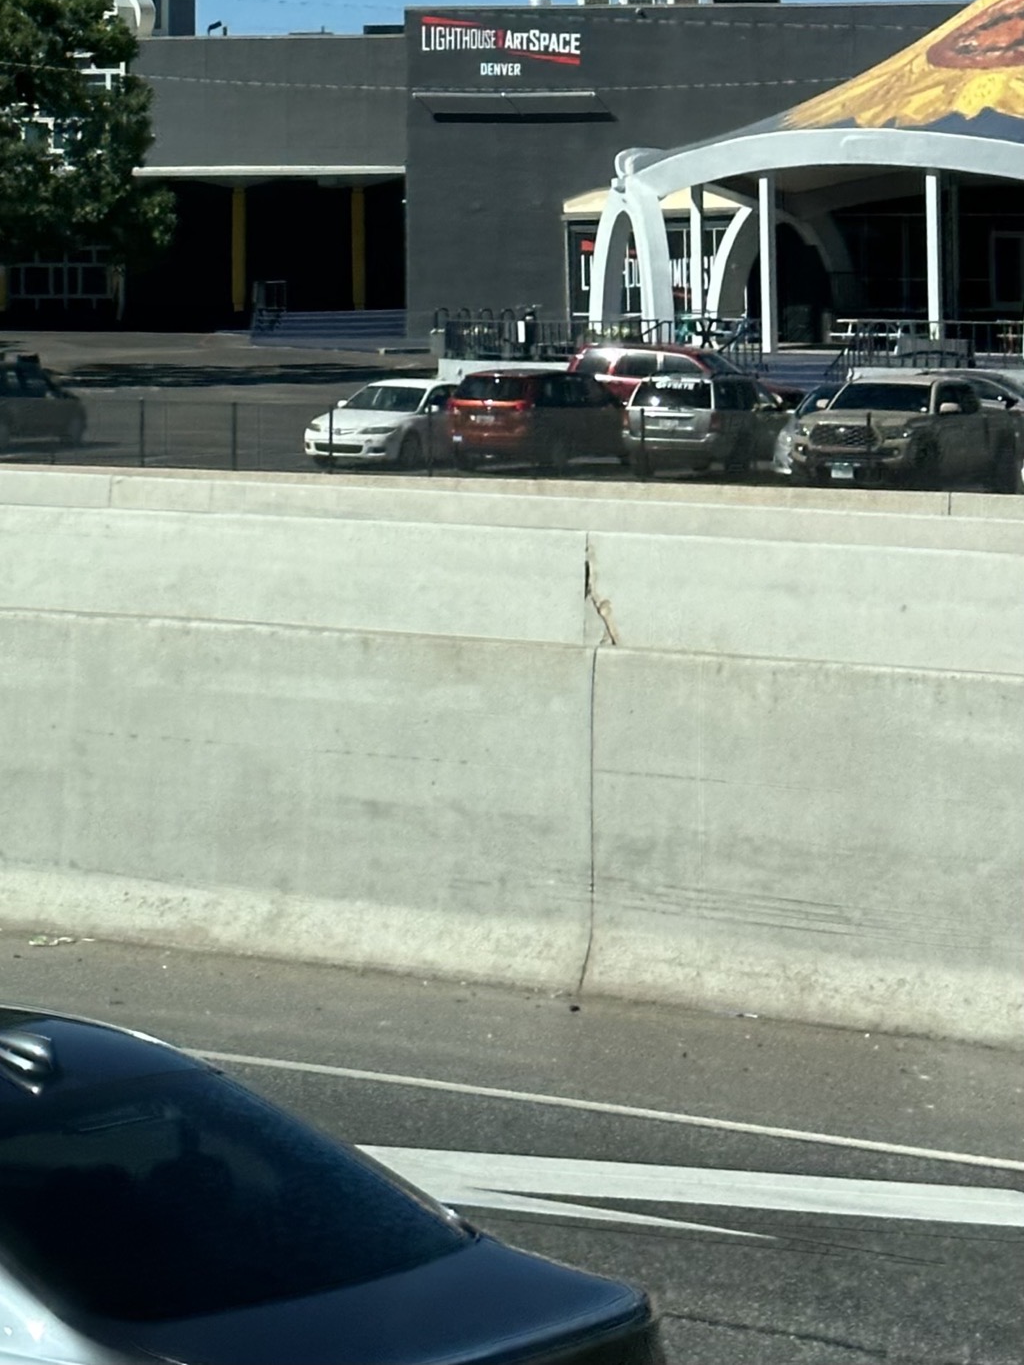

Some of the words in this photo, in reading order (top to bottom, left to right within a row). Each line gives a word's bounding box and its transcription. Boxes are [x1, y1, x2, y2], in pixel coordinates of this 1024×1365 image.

[421, 25, 497, 51] LIGHTHOUSE
[504, 29, 581, 55] ARTSPACE
[480, 62, 521, 76] DENVER
